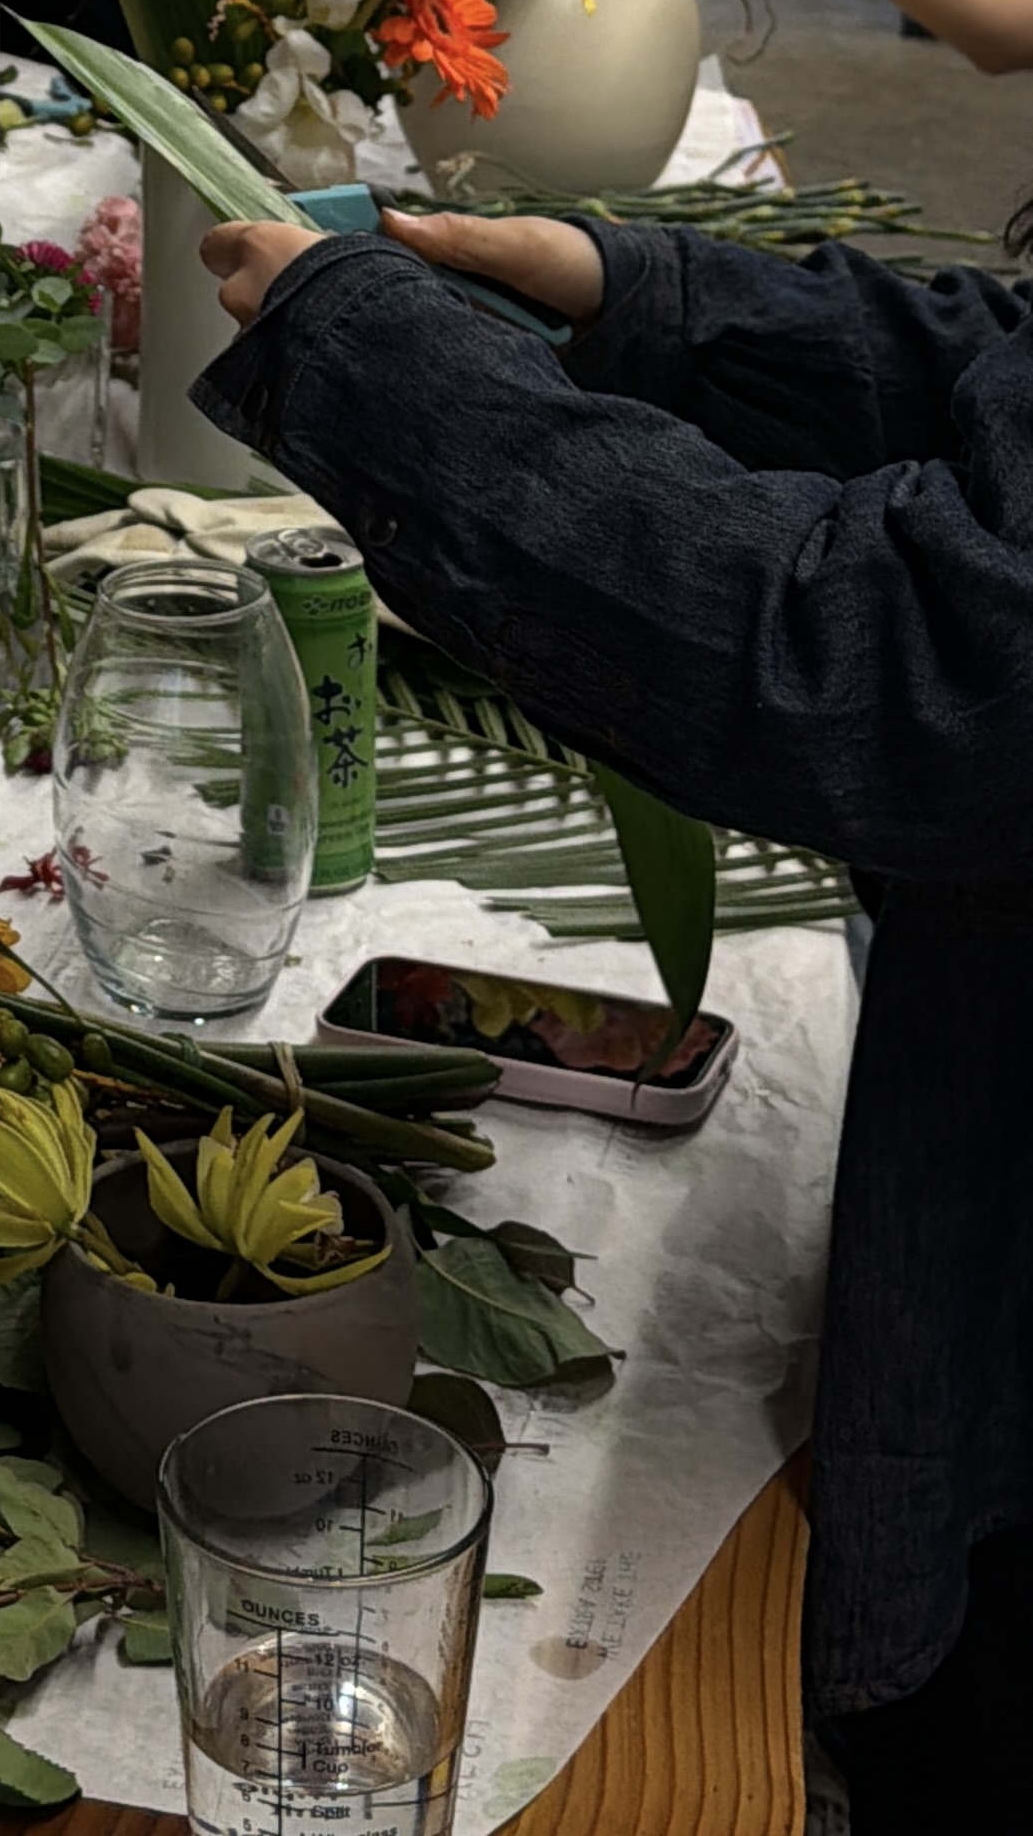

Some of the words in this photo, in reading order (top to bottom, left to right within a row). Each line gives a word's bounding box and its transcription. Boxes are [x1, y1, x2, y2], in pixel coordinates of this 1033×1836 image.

[240, 1599, 320, 1628] OUNCES
[314, 1653, 335, 1667] 12
[315, 1697, 335, 1712] 10
[313, 1759, 349, 1775] Cup
